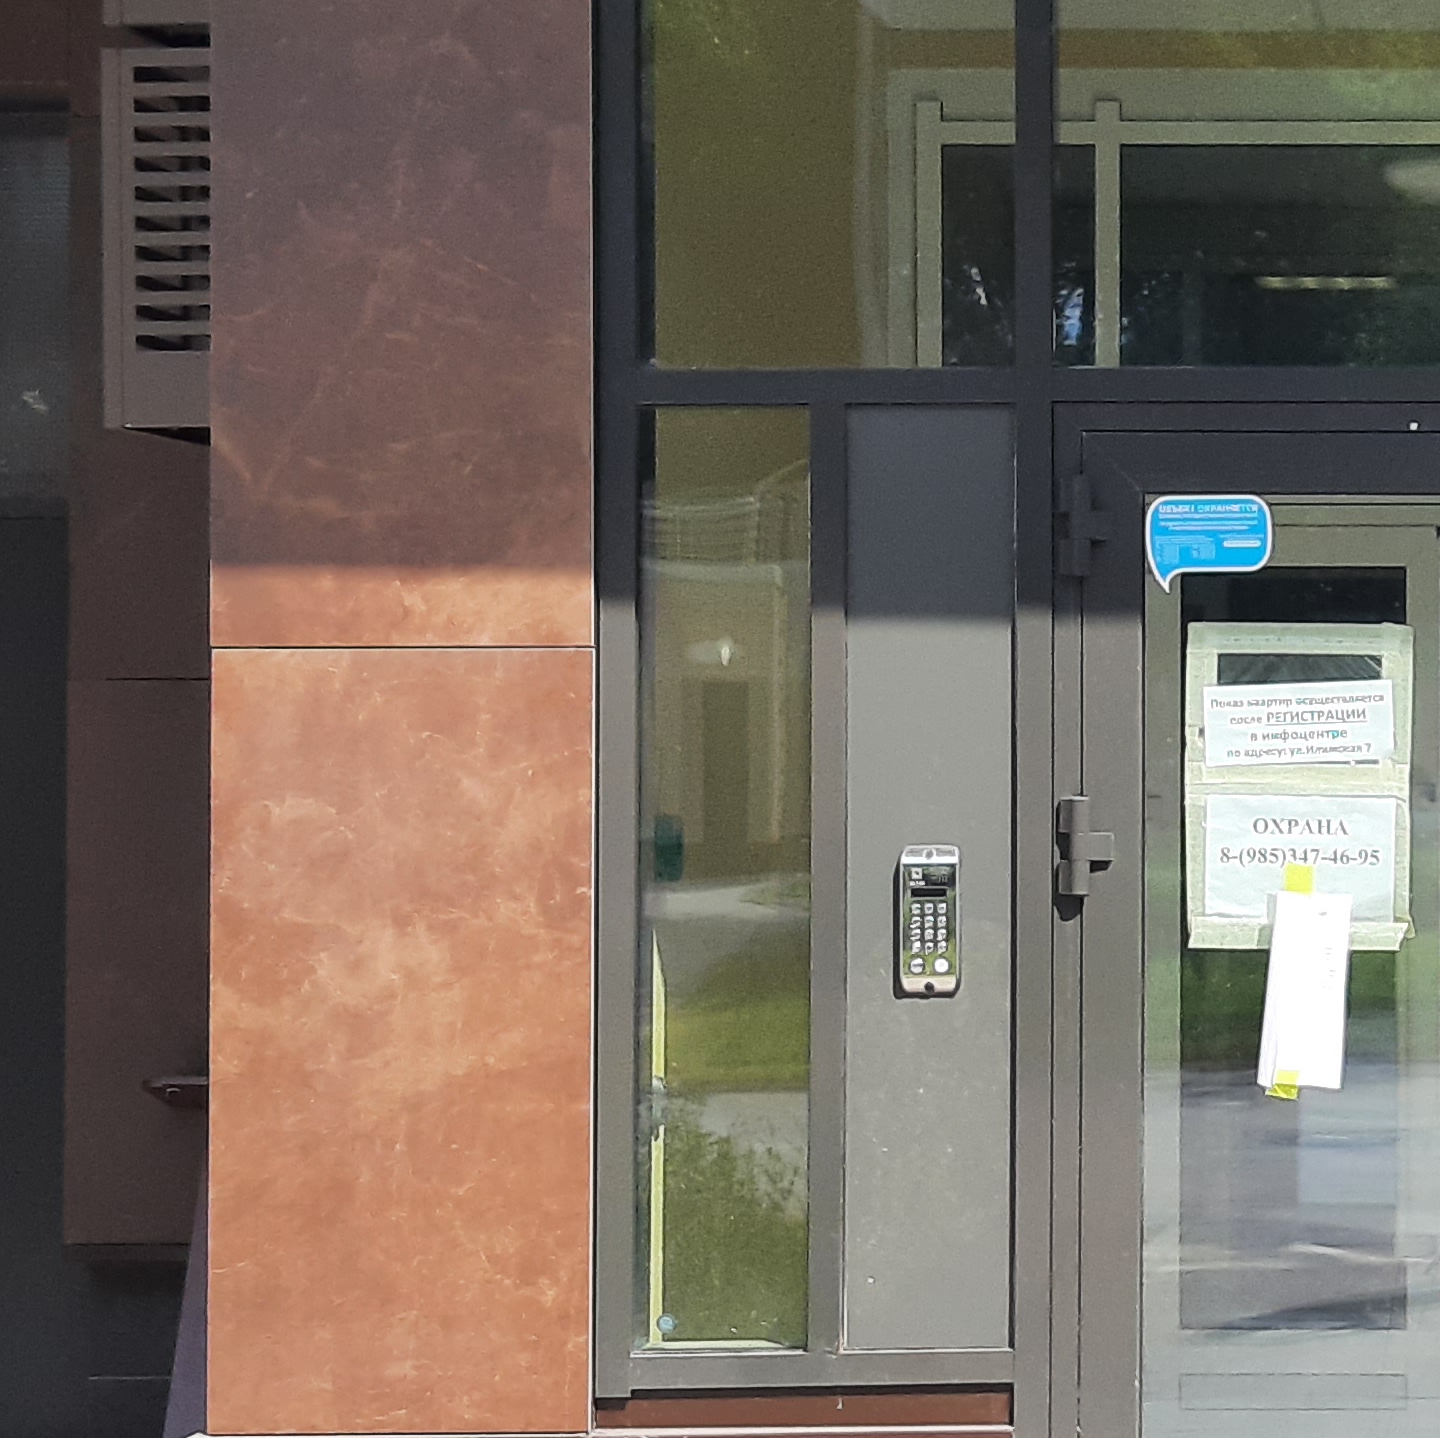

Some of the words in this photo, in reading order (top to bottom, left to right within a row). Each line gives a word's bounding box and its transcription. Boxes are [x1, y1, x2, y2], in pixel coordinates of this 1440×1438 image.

[1266, 707, 1368, 724] РЕГИСТРАЦИИ
[1262, 728, 1348, 742] инфоцентре
[1252, 817, 1350, 836] ОХРАНА
